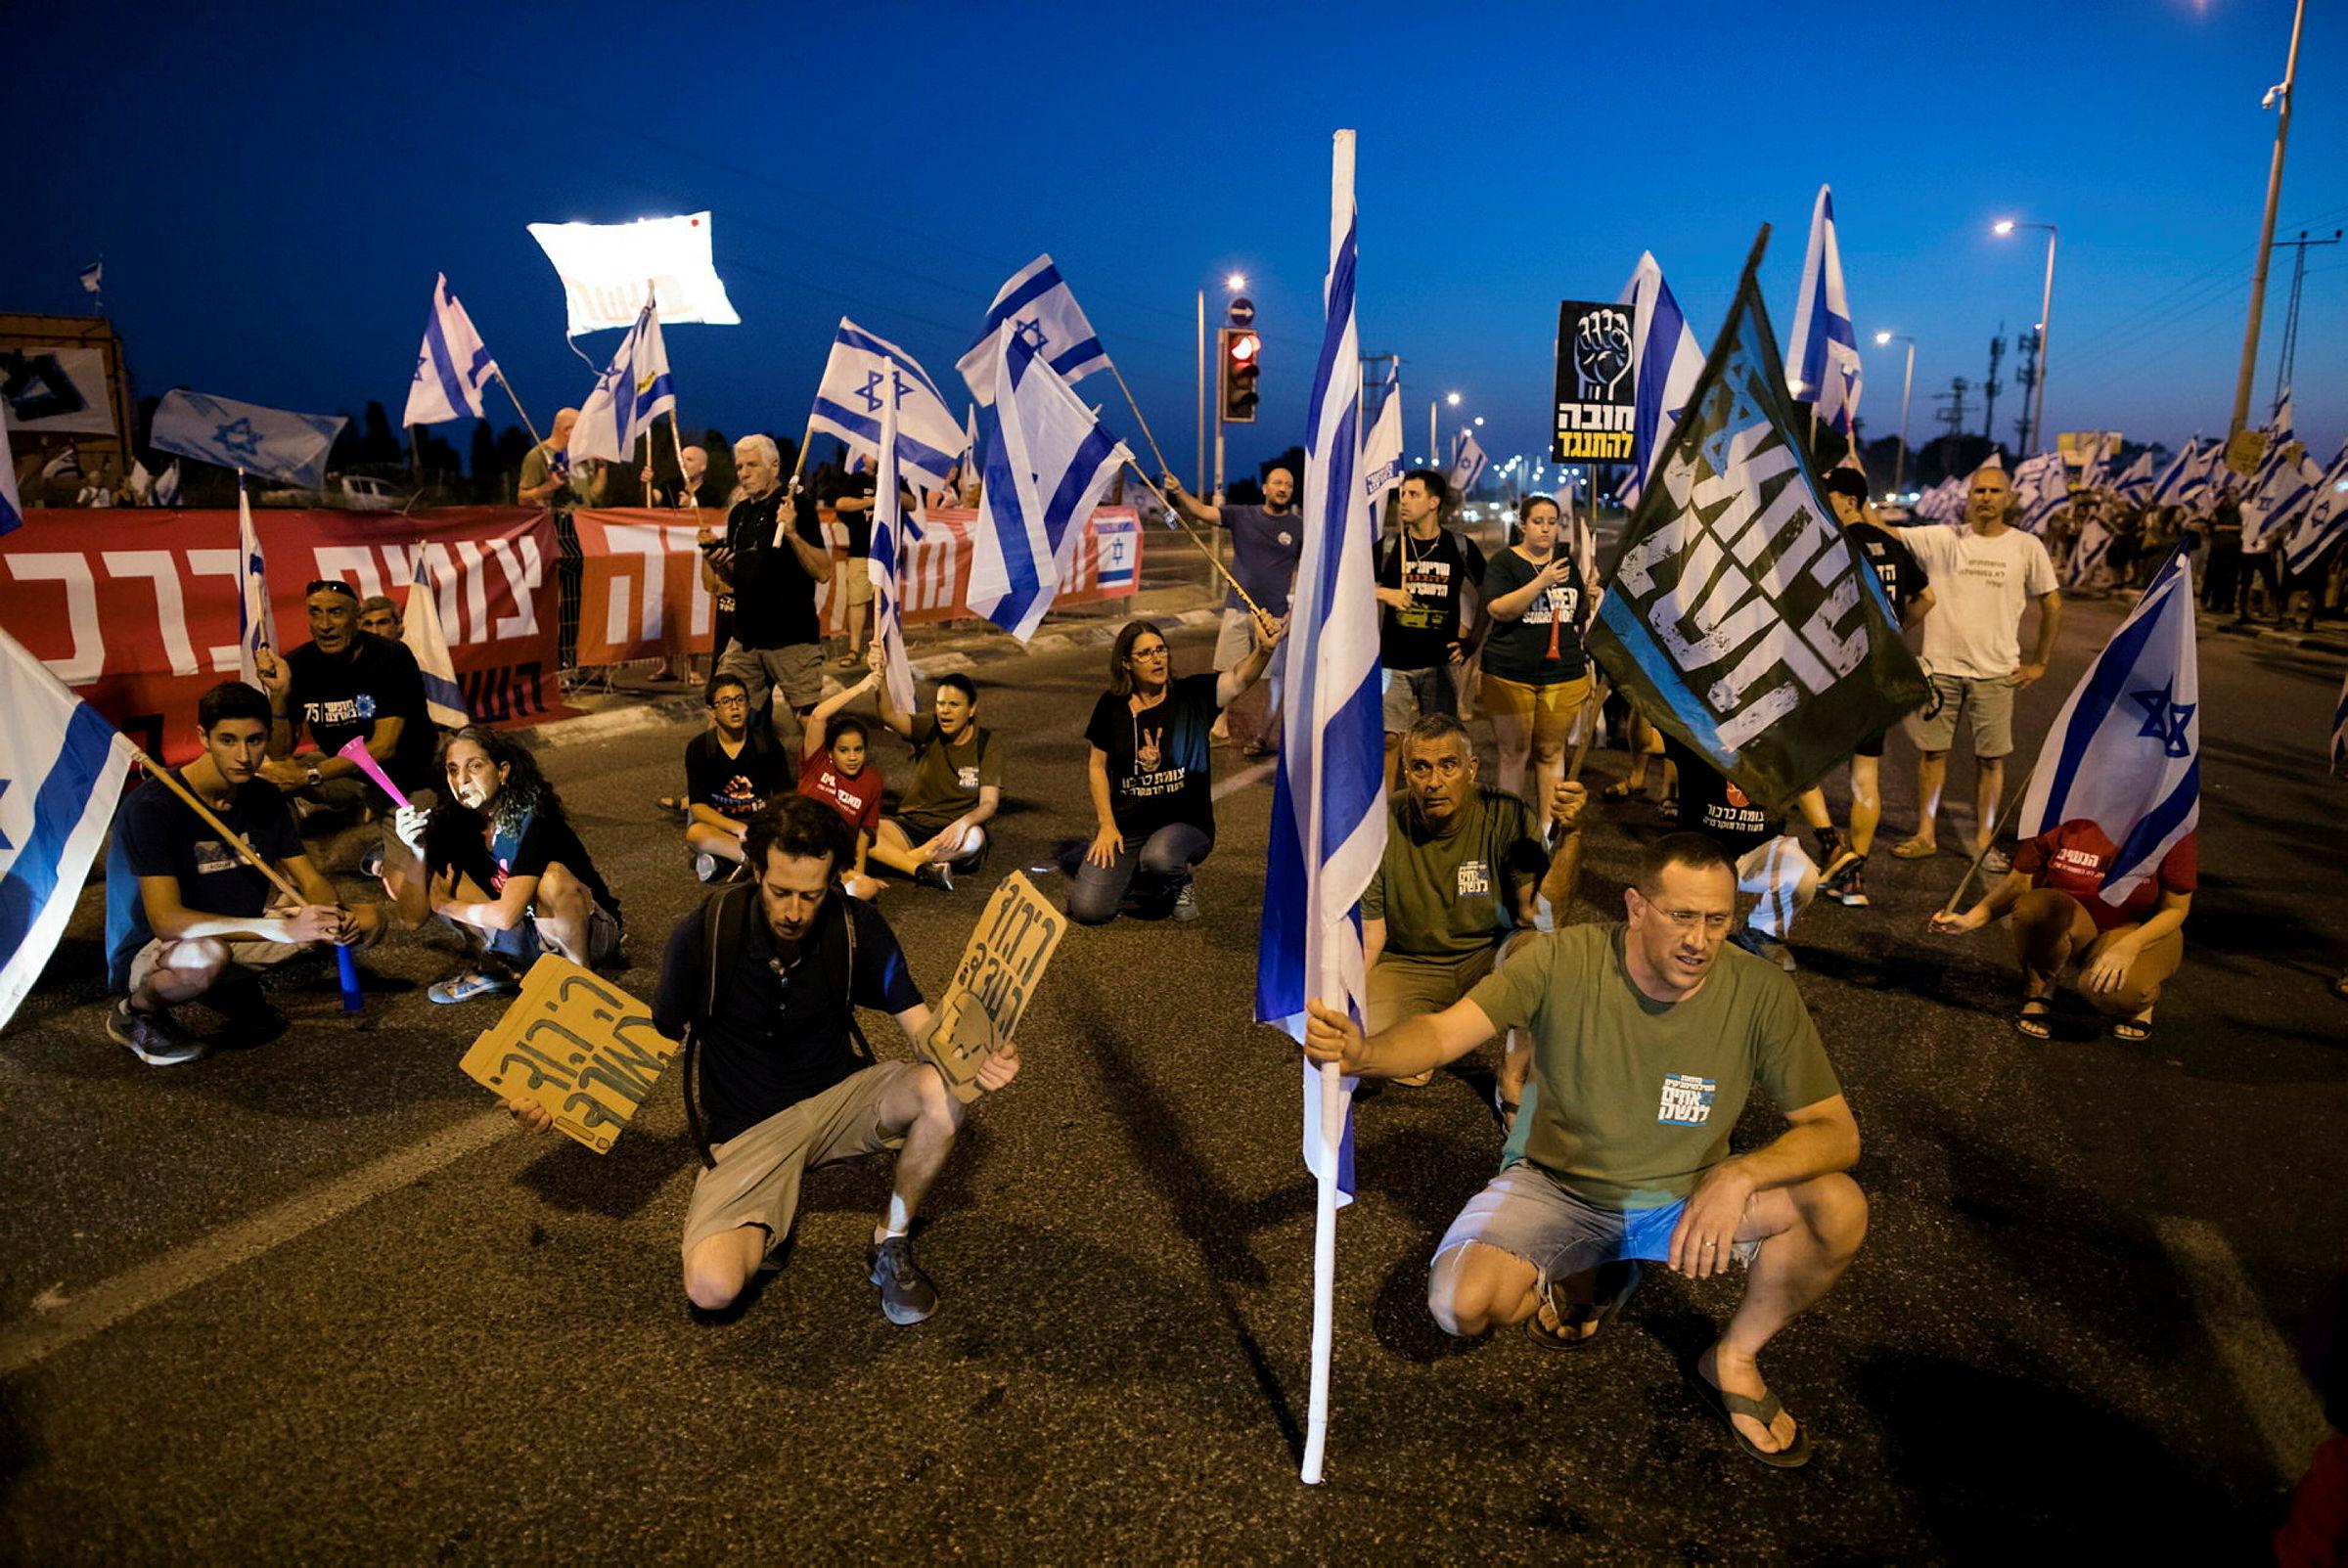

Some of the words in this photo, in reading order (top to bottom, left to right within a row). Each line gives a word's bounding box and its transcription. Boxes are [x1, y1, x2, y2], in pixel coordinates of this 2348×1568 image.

[1558, 402, 1635, 431] חובה
[1558, 430, 1634, 460] להתנגד
[303, 702, 320, 723] 75
[1707, 803, 1738, 821] כרכור
